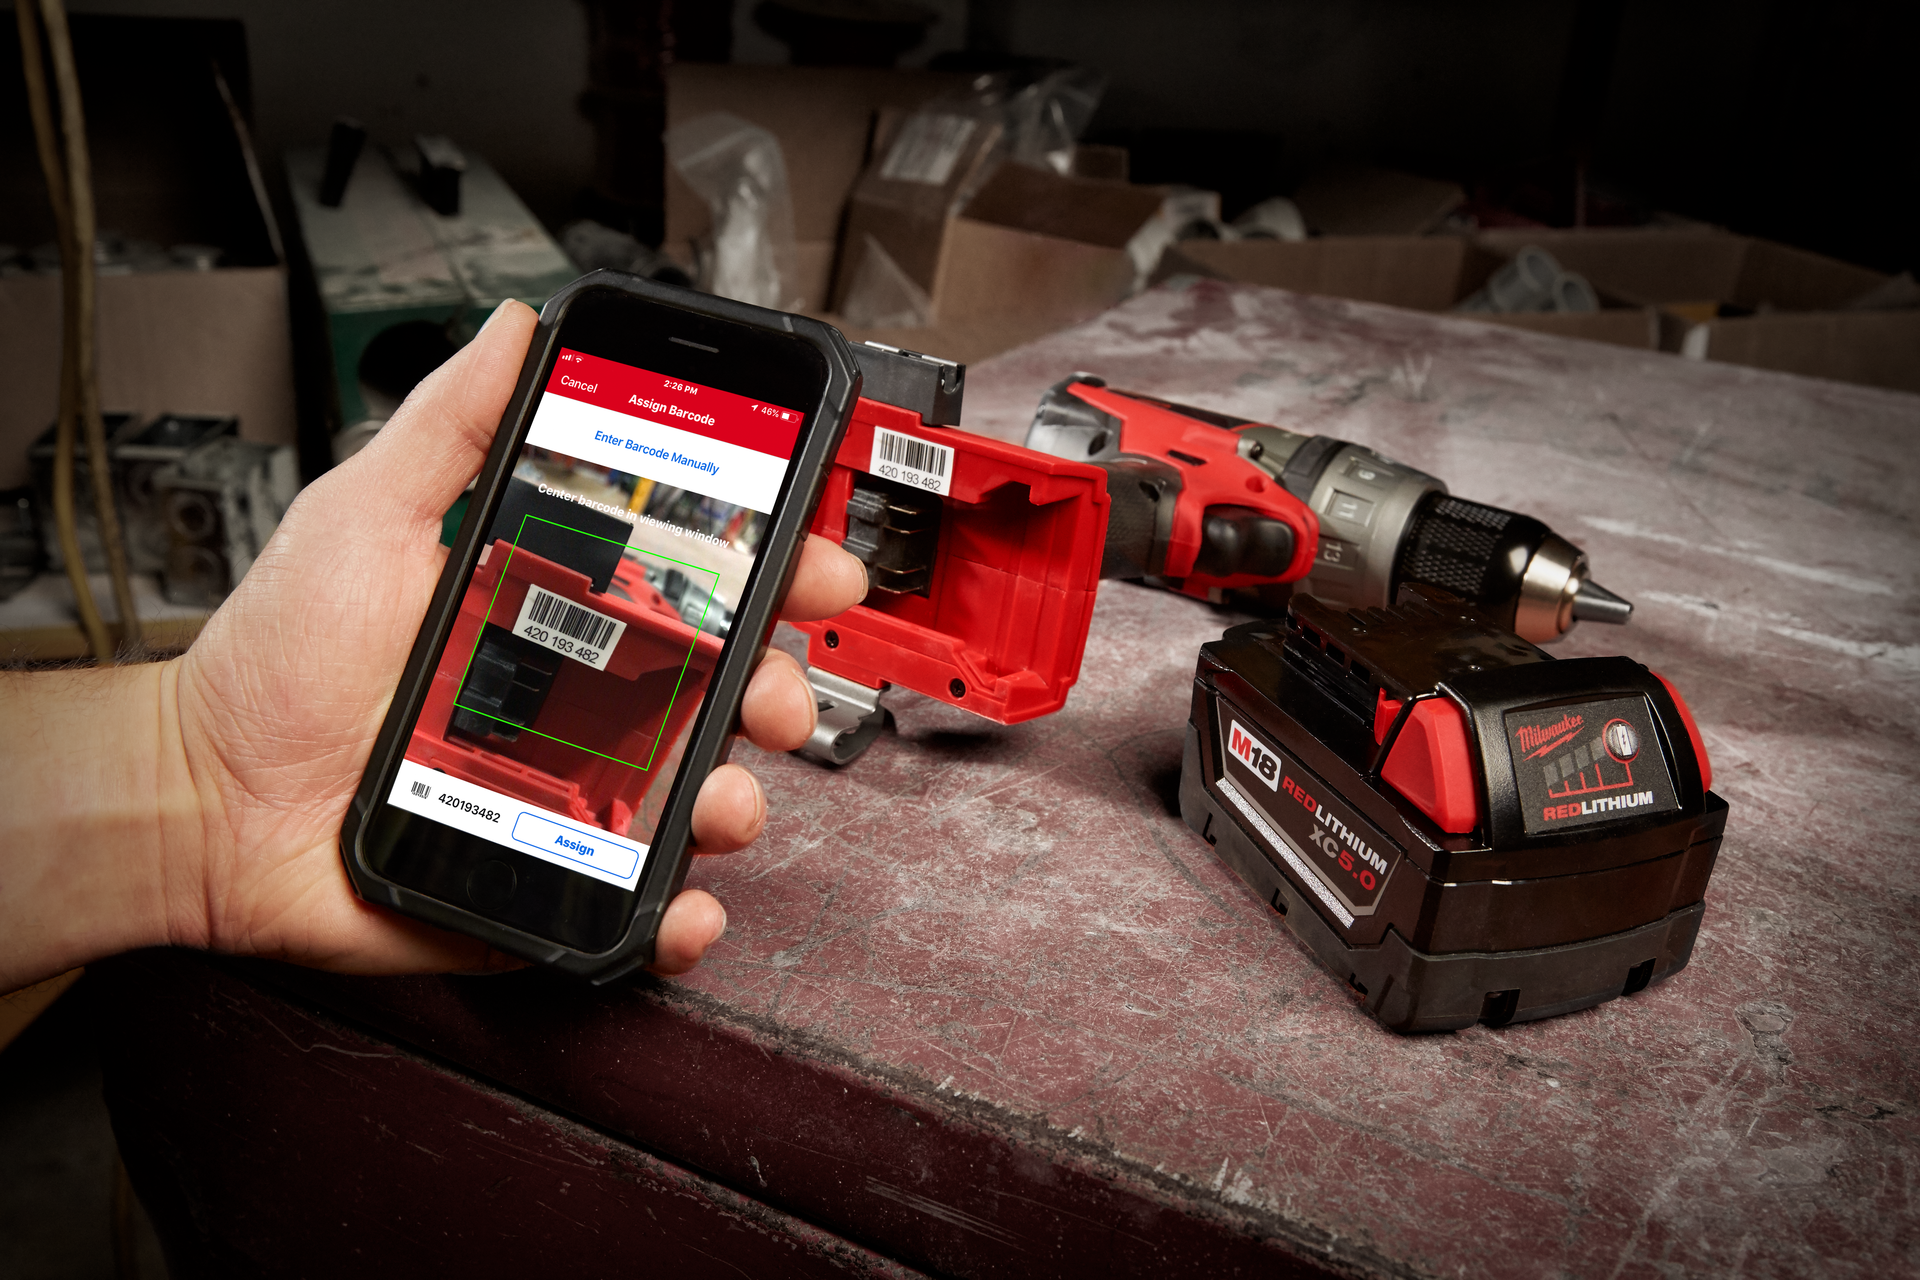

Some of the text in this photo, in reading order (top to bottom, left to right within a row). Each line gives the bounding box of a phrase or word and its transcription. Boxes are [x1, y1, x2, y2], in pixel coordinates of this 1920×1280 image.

[560, 375, 598, 394] Cancel
[664, 380, 698, 396] 2:26 PM
[628, 394, 716, 427] Assign Barcode
[761, 406, 780, 418] 46%
[594, 430, 720, 476] Enter Barcode Manually
[879, 465, 941, 492] 420 193 482
[538, 483, 730, 549] Center barcode in viewing window
[1323, 542, 1343, 562] 13
[523, 625, 600, 664] 420 193 482
[1514, 714, 1584, 753] Milwaukee
[1231, 727, 1277, 782] M18
[438, 792, 502, 824] 420193482
[1543, 790, 1653, 821] REDLITHIUM
[1282, 775, 1388, 875] REDLITHIUM
[554, 834, 595, 857] Assign
